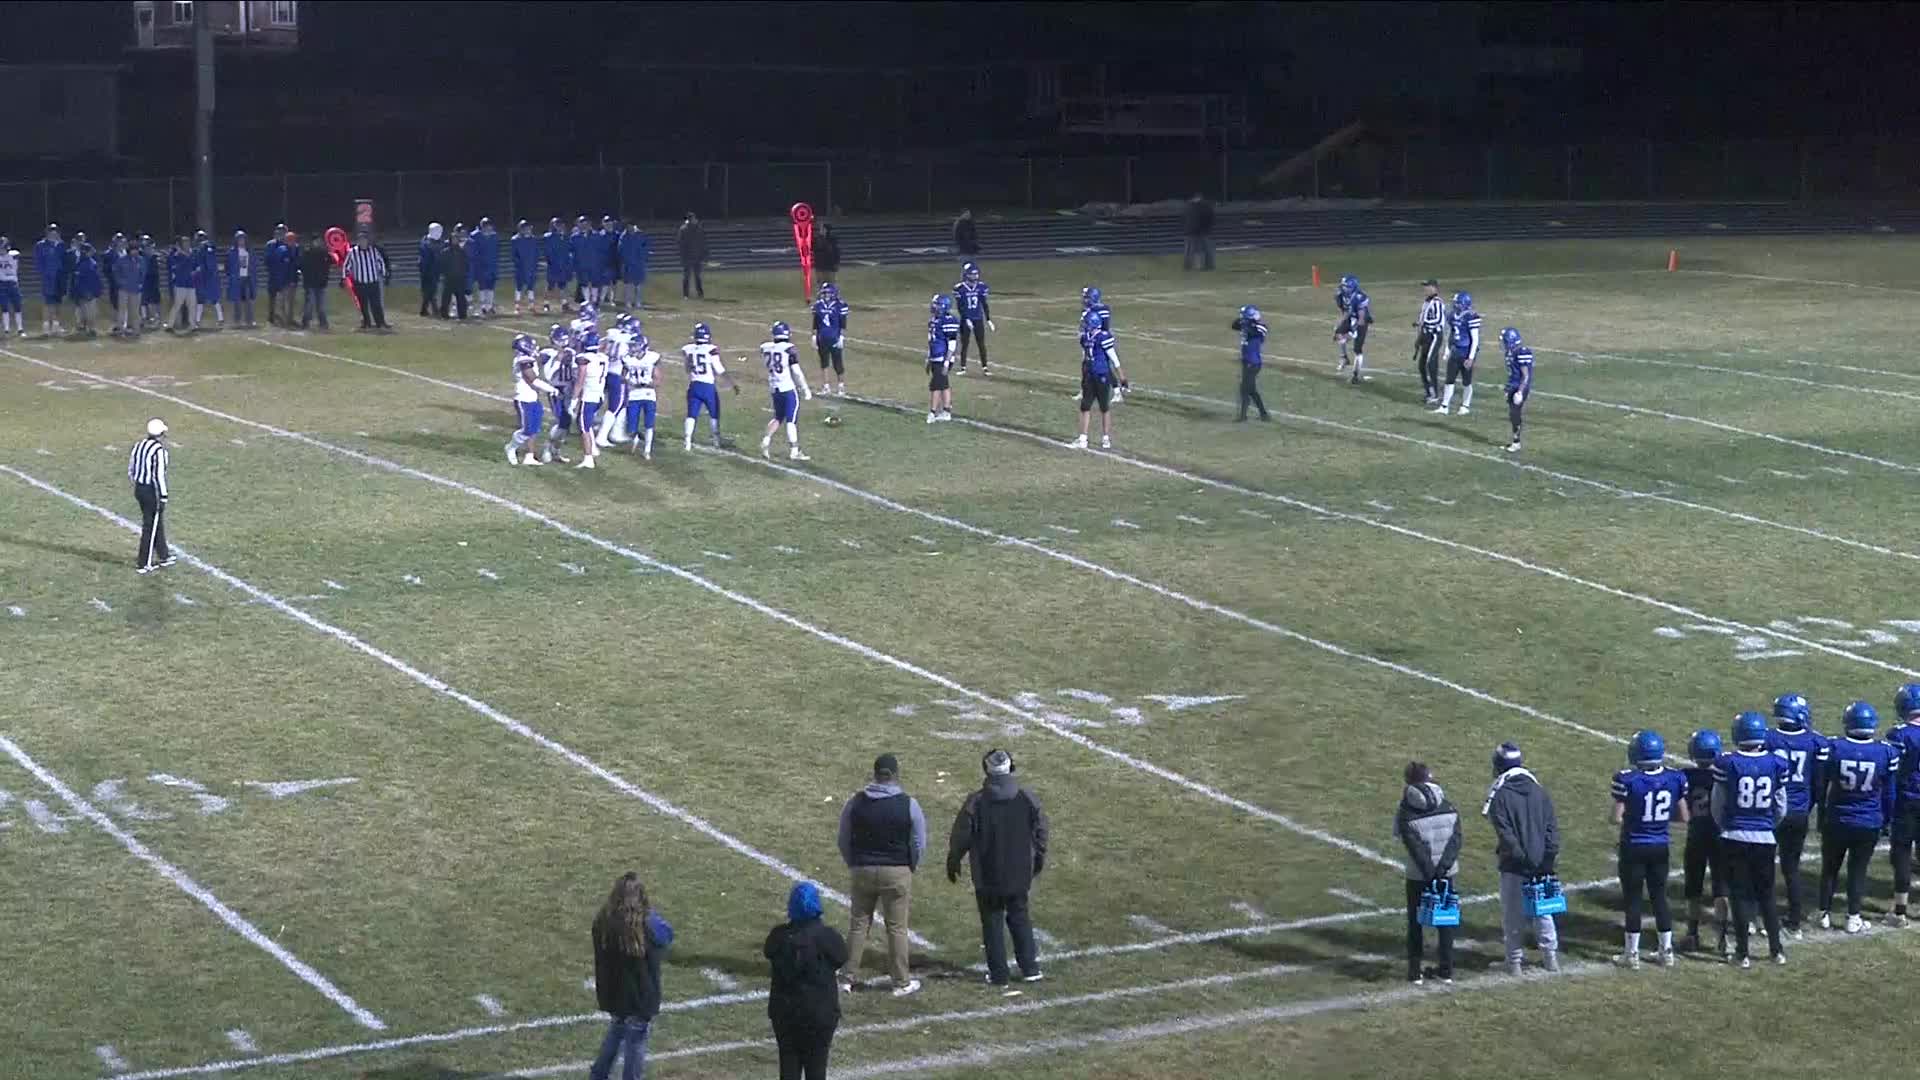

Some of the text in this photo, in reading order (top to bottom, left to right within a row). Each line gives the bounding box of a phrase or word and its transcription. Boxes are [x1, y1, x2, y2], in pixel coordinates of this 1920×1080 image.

[966, 296, 979, 309] 13
[822, 314, 831, 327] 4
[1840, 759, 1876, 792] 57
[1641, 789, 1672, 822] 12
[1737, 776, 1772, 809] 82
